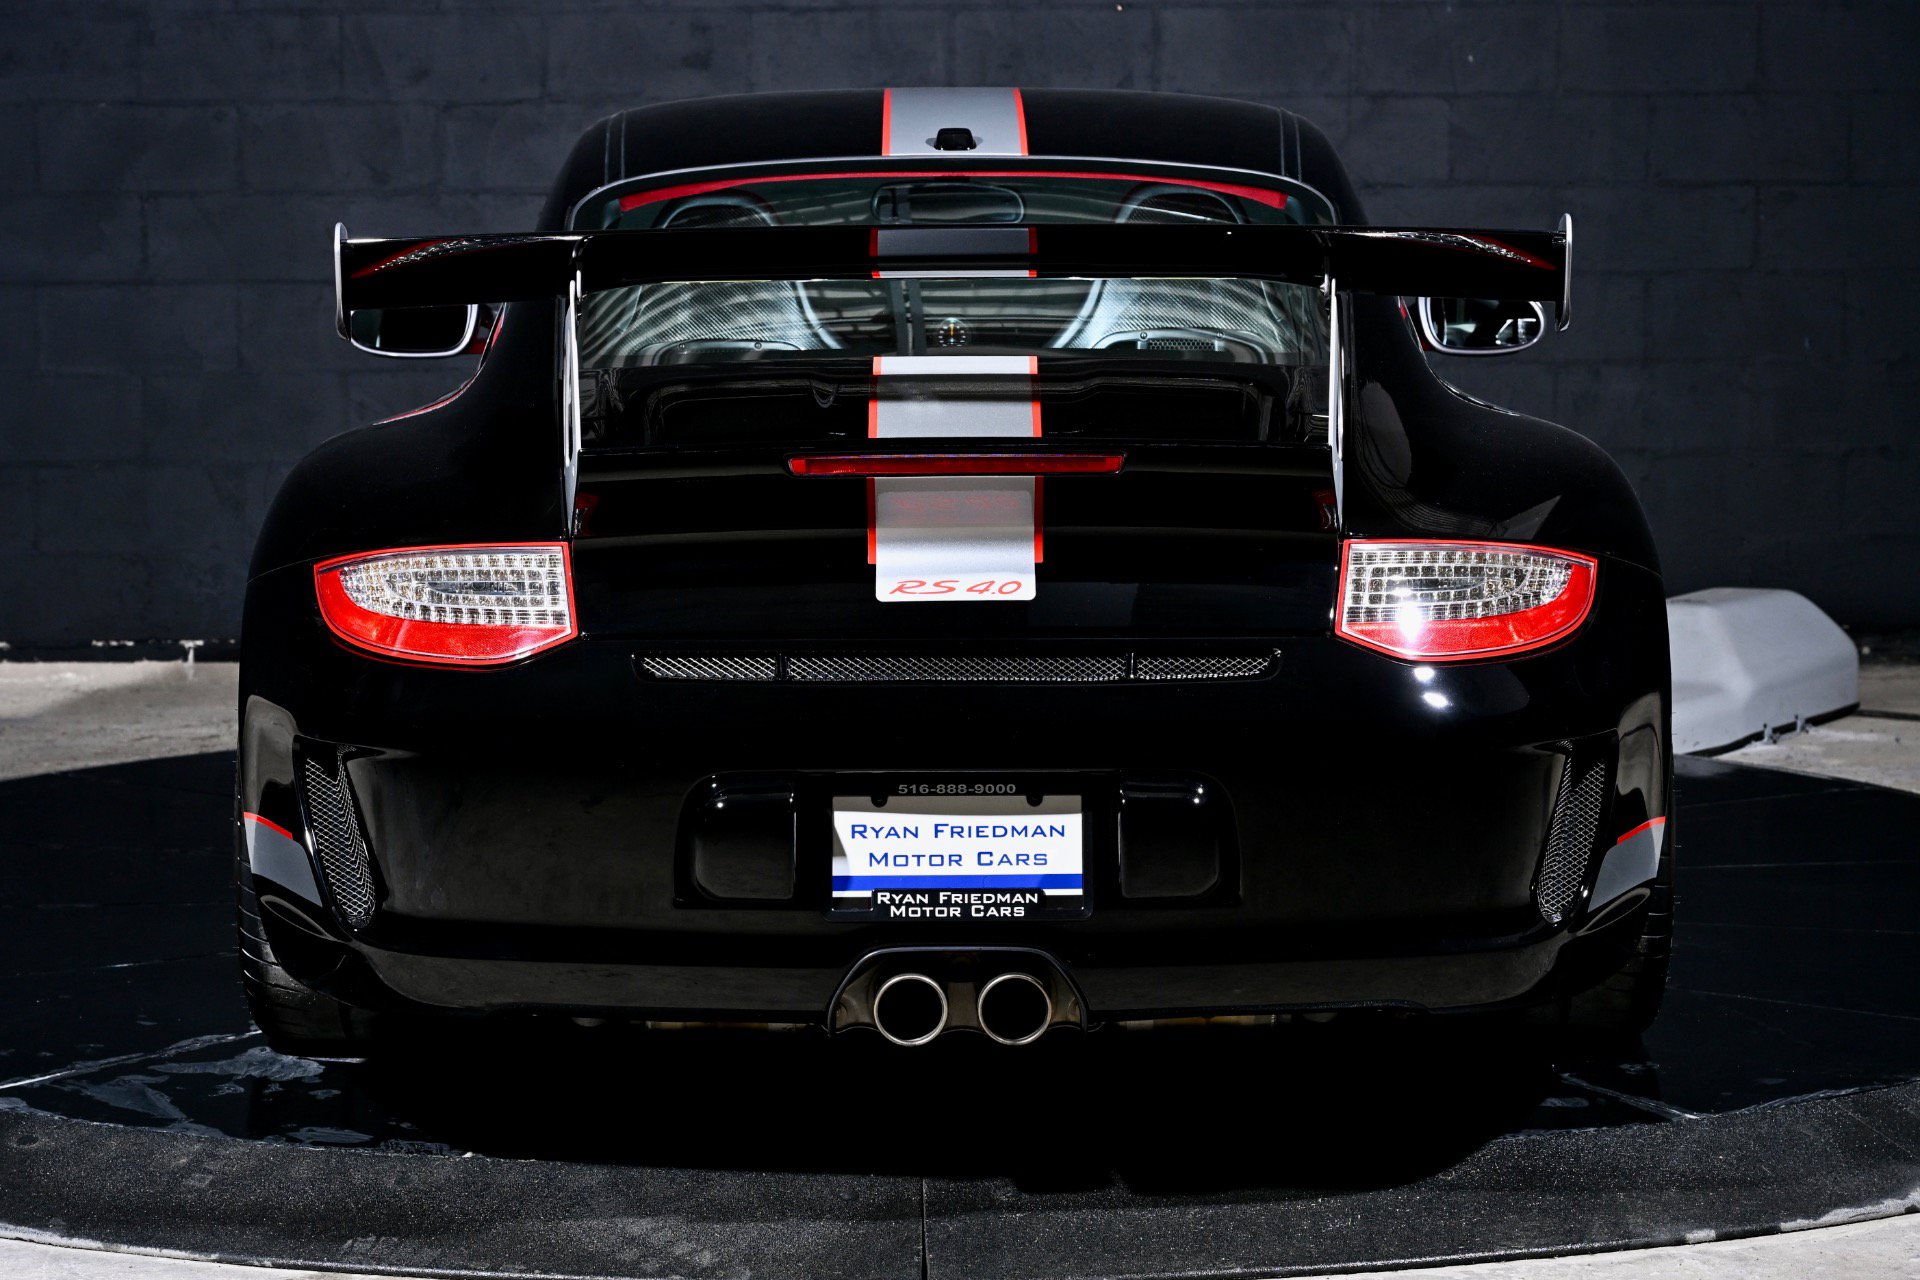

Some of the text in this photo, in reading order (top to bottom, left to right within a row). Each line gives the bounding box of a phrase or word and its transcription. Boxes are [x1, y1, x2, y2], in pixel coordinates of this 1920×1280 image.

[889, 579, 1023, 595] RS 4.0
[898, 783, 1016, 794] 516-888-9000
[850, 823, 1066, 839] RYAN FRIEDMAN
[868, 851, 1049, 868] MOTOR CARS
[876, 891, 1038, 905] RYAN FRIEDMAN
[890, 905, 1025, 918] MOTOR CARS
